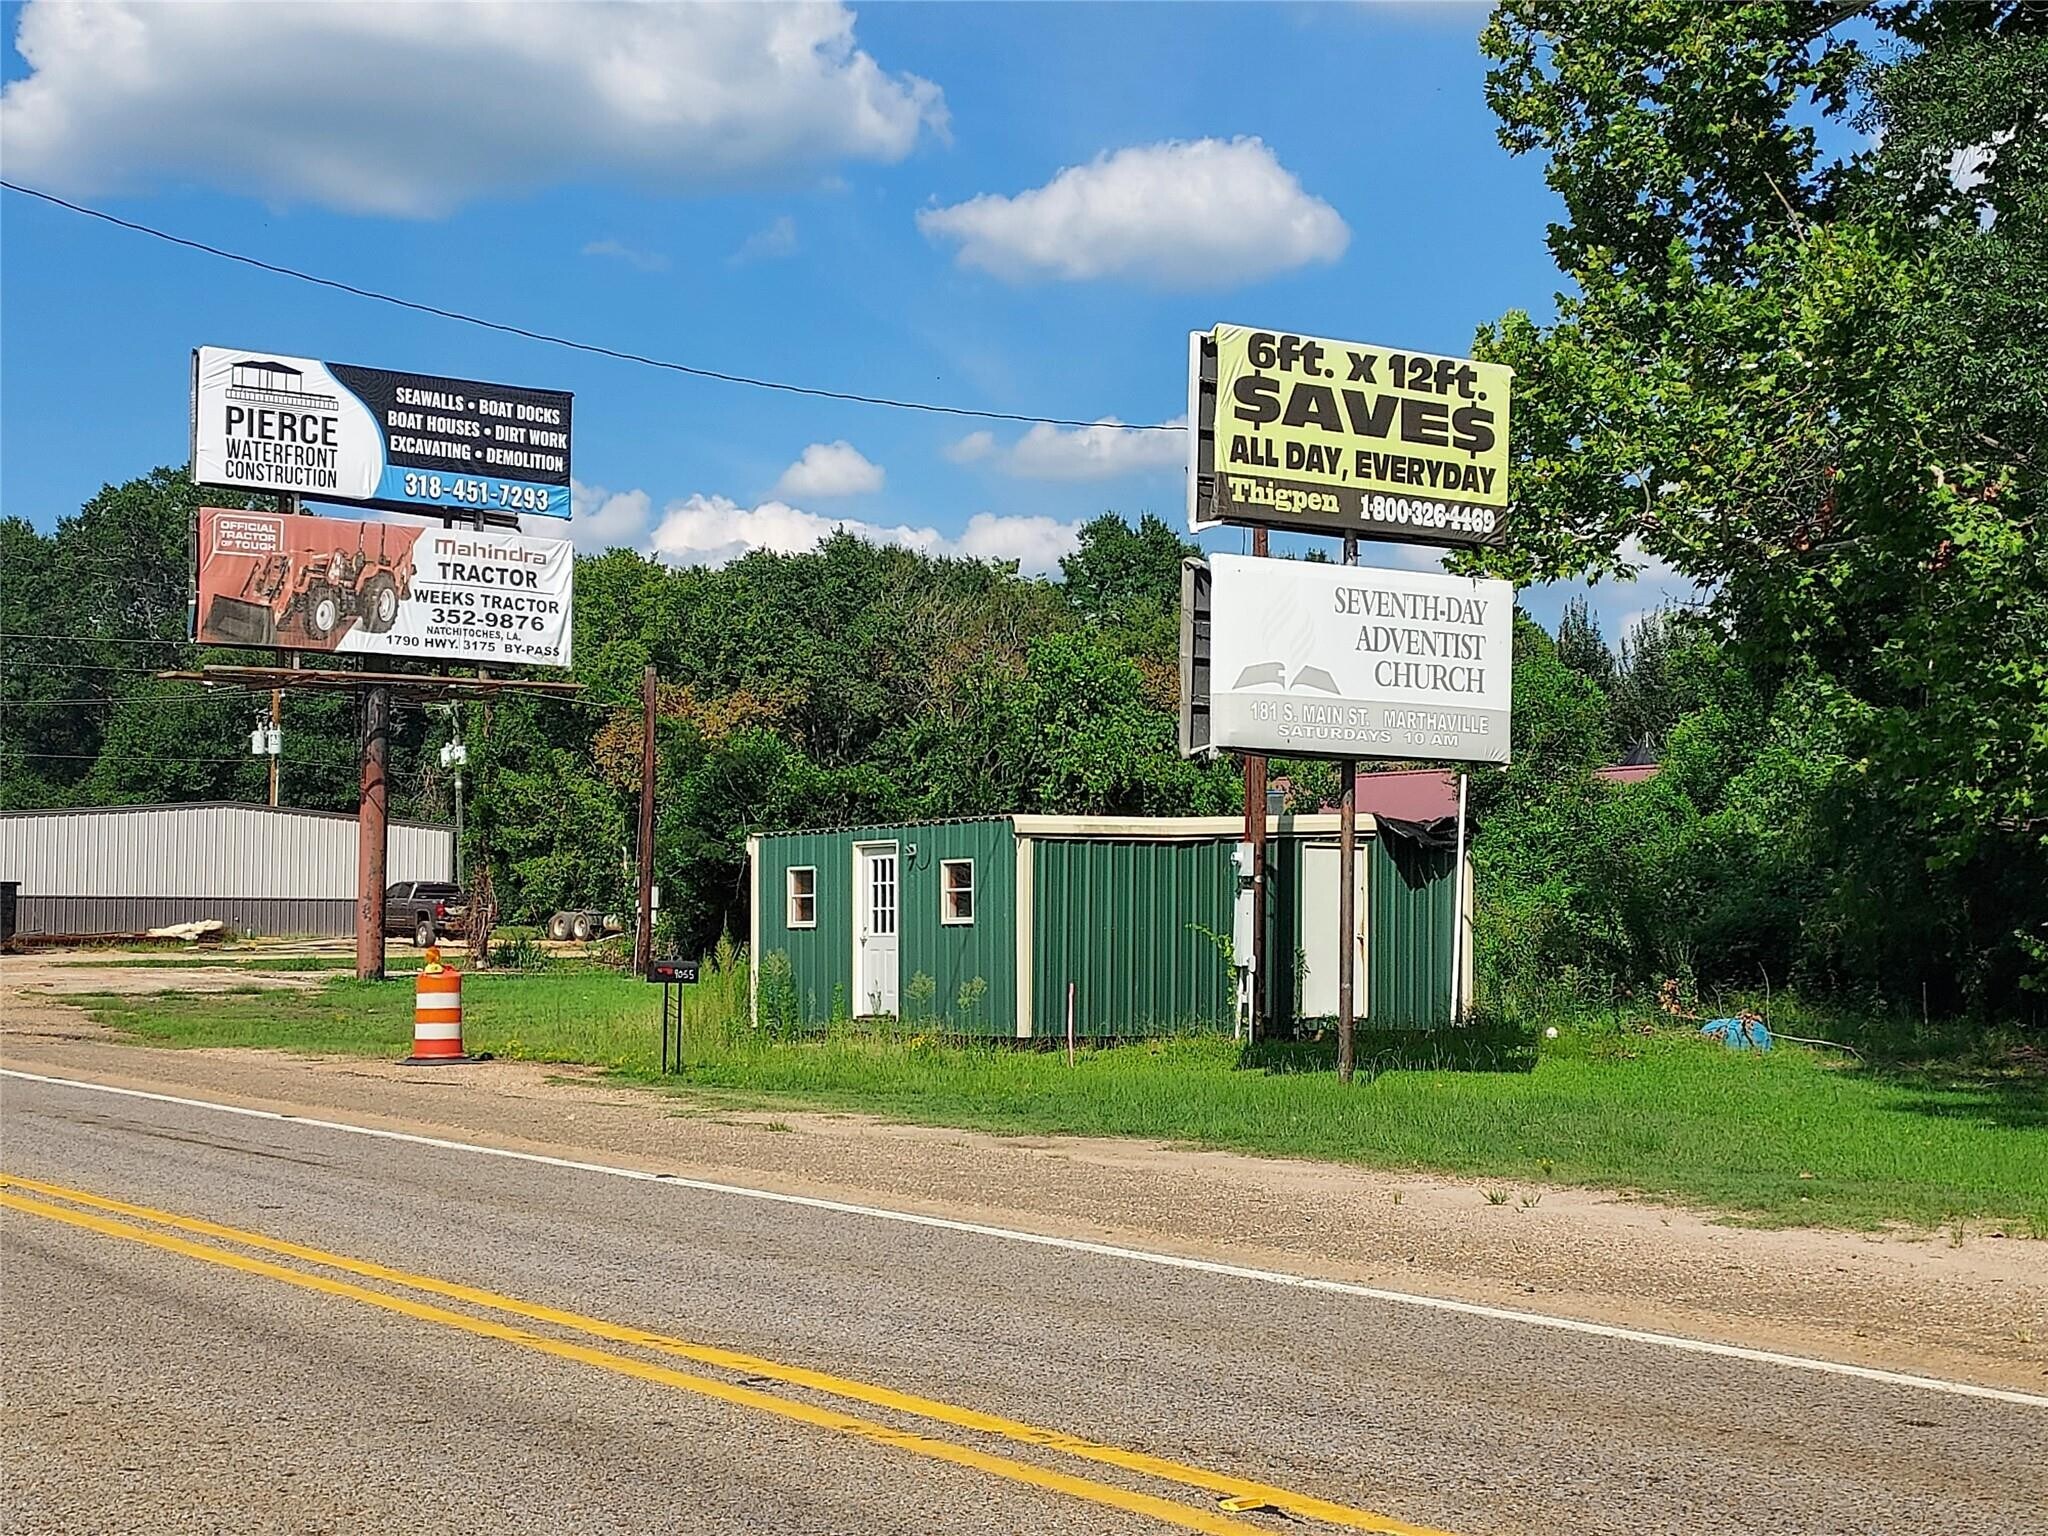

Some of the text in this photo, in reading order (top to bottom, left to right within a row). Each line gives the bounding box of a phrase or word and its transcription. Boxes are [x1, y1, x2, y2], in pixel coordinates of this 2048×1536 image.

[1248, 332, 1334, 378] 6ft.
[1389, 354, 1486, 401] 12ft.
[396, 387, 560, 424] SEAWALLS BOAT DOCKS
[226, 406, 338, 447] PIERCE
[388, 410, 568, 449] BOAT HOUSES DIRT WORK
[226, 438, 337, 468] WATERFRONT
[390, 436, 563, 472] EXCAVATING DEMOLITION
[1230, 436, 1496, 494] ALL DAY, EVERYDAY
[225, 460, 337, 489] CONSTRUCTION
[405, 473, 549, 511] 318-451-7293
[1229, 477, 1339, 513] Thigpen
[220, 520, 276, 533] OFFICIAL
[220, 530, 276, 542] TRACTOR
[233, 541, 276, 551] TOUGH
[434, 539, 546, 565] Mahindra
[438, 562, 538, 588] TRACTOR
[414, 589, 559, 614] WEEKS TRACTOR
[1335, 587, 1488, 625] SEVENTH-DAY
[427, 626, 521, 641] NATCHITOCHES, LA.
[431, 608, 544, 631] 352-9876
[386, 635, 560, 656] 1790 HWY. 3175 BY-PASS
[1355, 626, 1486, 660] ADVENTIST
[1375, 661, 1485, 693] CHURCH
[1251, 702, 1489, 734] 181 S. MAIN ST. MARTHAVILLE
[1278, 725, 1458, 746] SATURDAYS 10 AM
